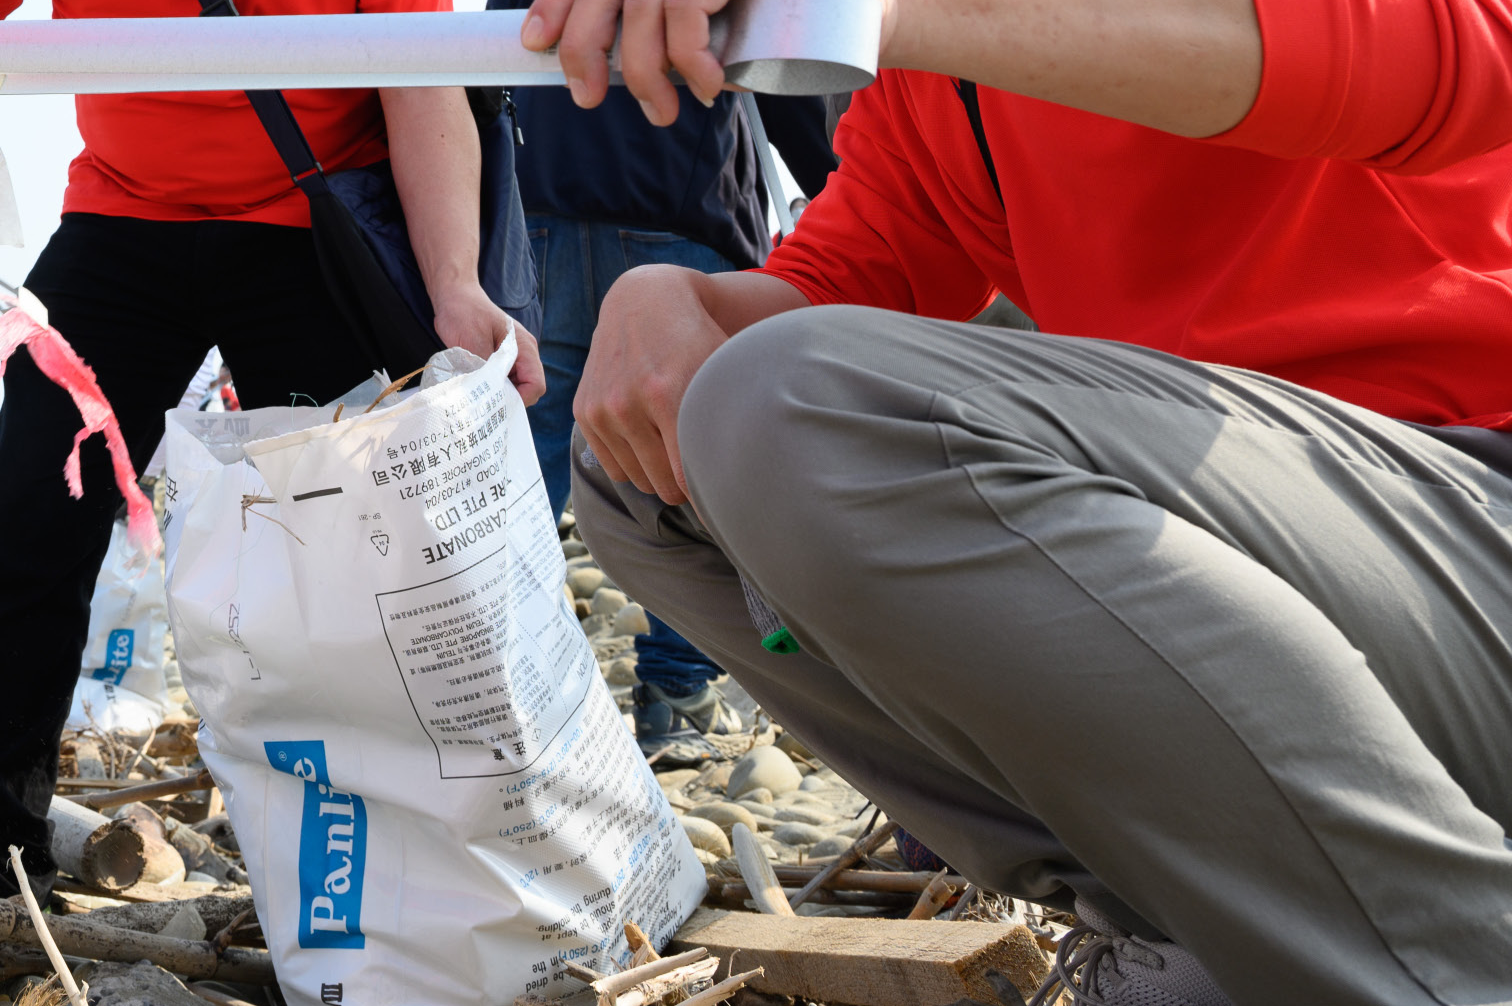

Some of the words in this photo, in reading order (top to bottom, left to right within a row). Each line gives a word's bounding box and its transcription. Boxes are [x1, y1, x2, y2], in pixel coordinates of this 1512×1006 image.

[440, 447, 490, 483] SINGAPORE
[475, 459, 499, 482] ROAD
[398, 476, 439, 500] 189721
[424, 478, 471, 509] #17-03/04
[461, 491, 486, 515] PTE
[429, 505, 460, 532] LTD.
[410, 625, 463, 645] POLYCARBONATE
[444, 638, 457, 647] PTE
[459, 624, 493, 643] SINGAPORE
[428, 642, 442, 651] LTD.
[293, 757, 355, 935] Panlie
[582, 887, 611, 906] during
[570, 902, 581, 915] the
[588, 900, 616, 923] should
[556, 928, 578, 938] kept
[579, 918, 588, 930] be
[540, 932, 552, 940] at
[530, 960, 547, 974] the
[549, 955, 560, 967] in
[524, 976, 549, 993] dried
[551, 970, 564, 983] be
